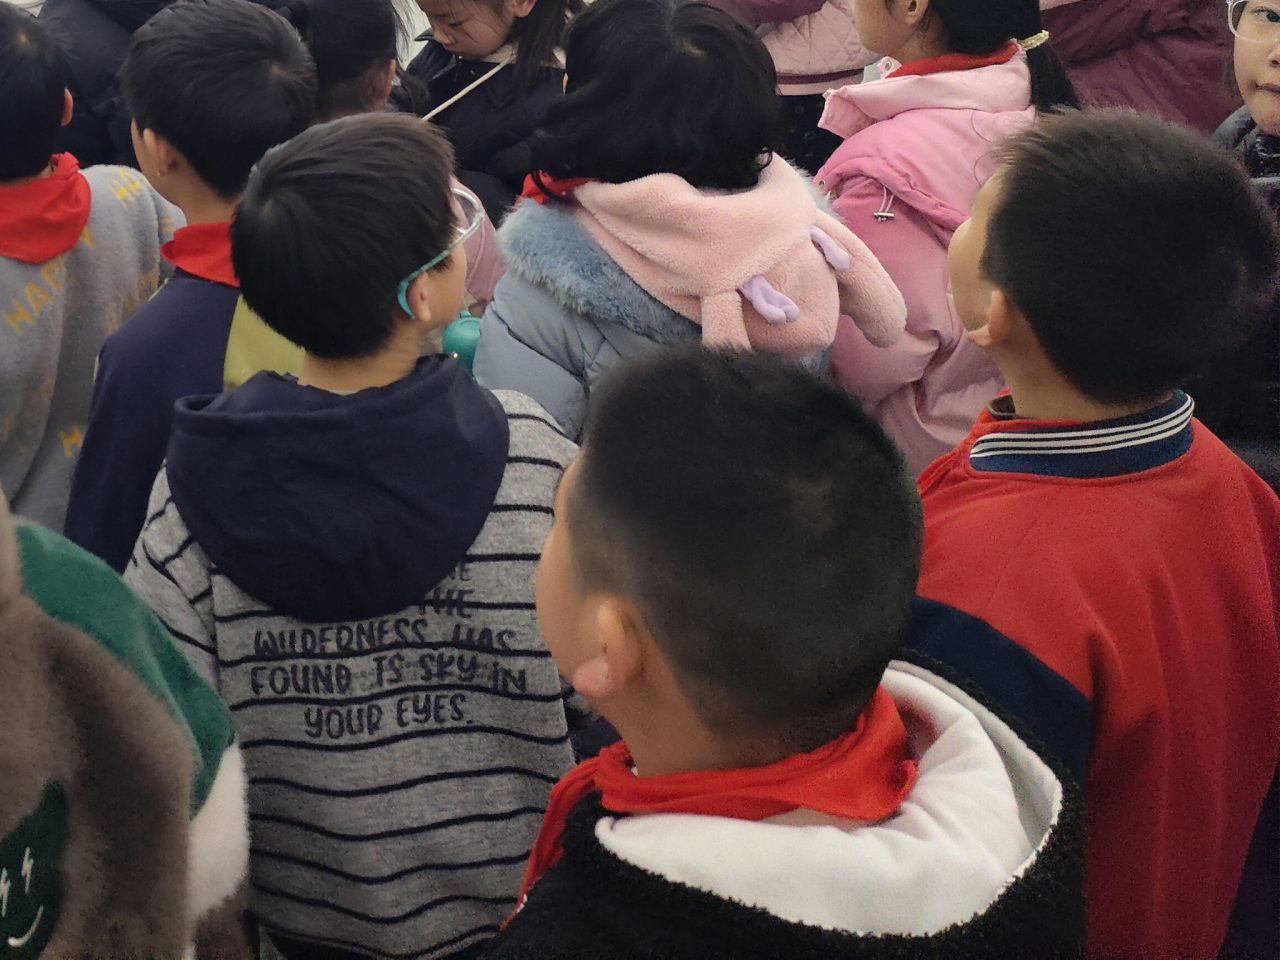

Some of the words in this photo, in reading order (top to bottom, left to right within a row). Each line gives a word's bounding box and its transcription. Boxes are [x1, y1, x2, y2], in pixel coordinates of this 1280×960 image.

[253, 617, 427, 658] WILDERNESS
[451, 622, 518, 652] HAS
[250, 662, 353, 696] FOUND
[372, 652, 406, 688] IS
[419, 652, 479, 685] SKY
[490, 662, 527, 694] IN
[304, 704, 384, 740] YOUR
